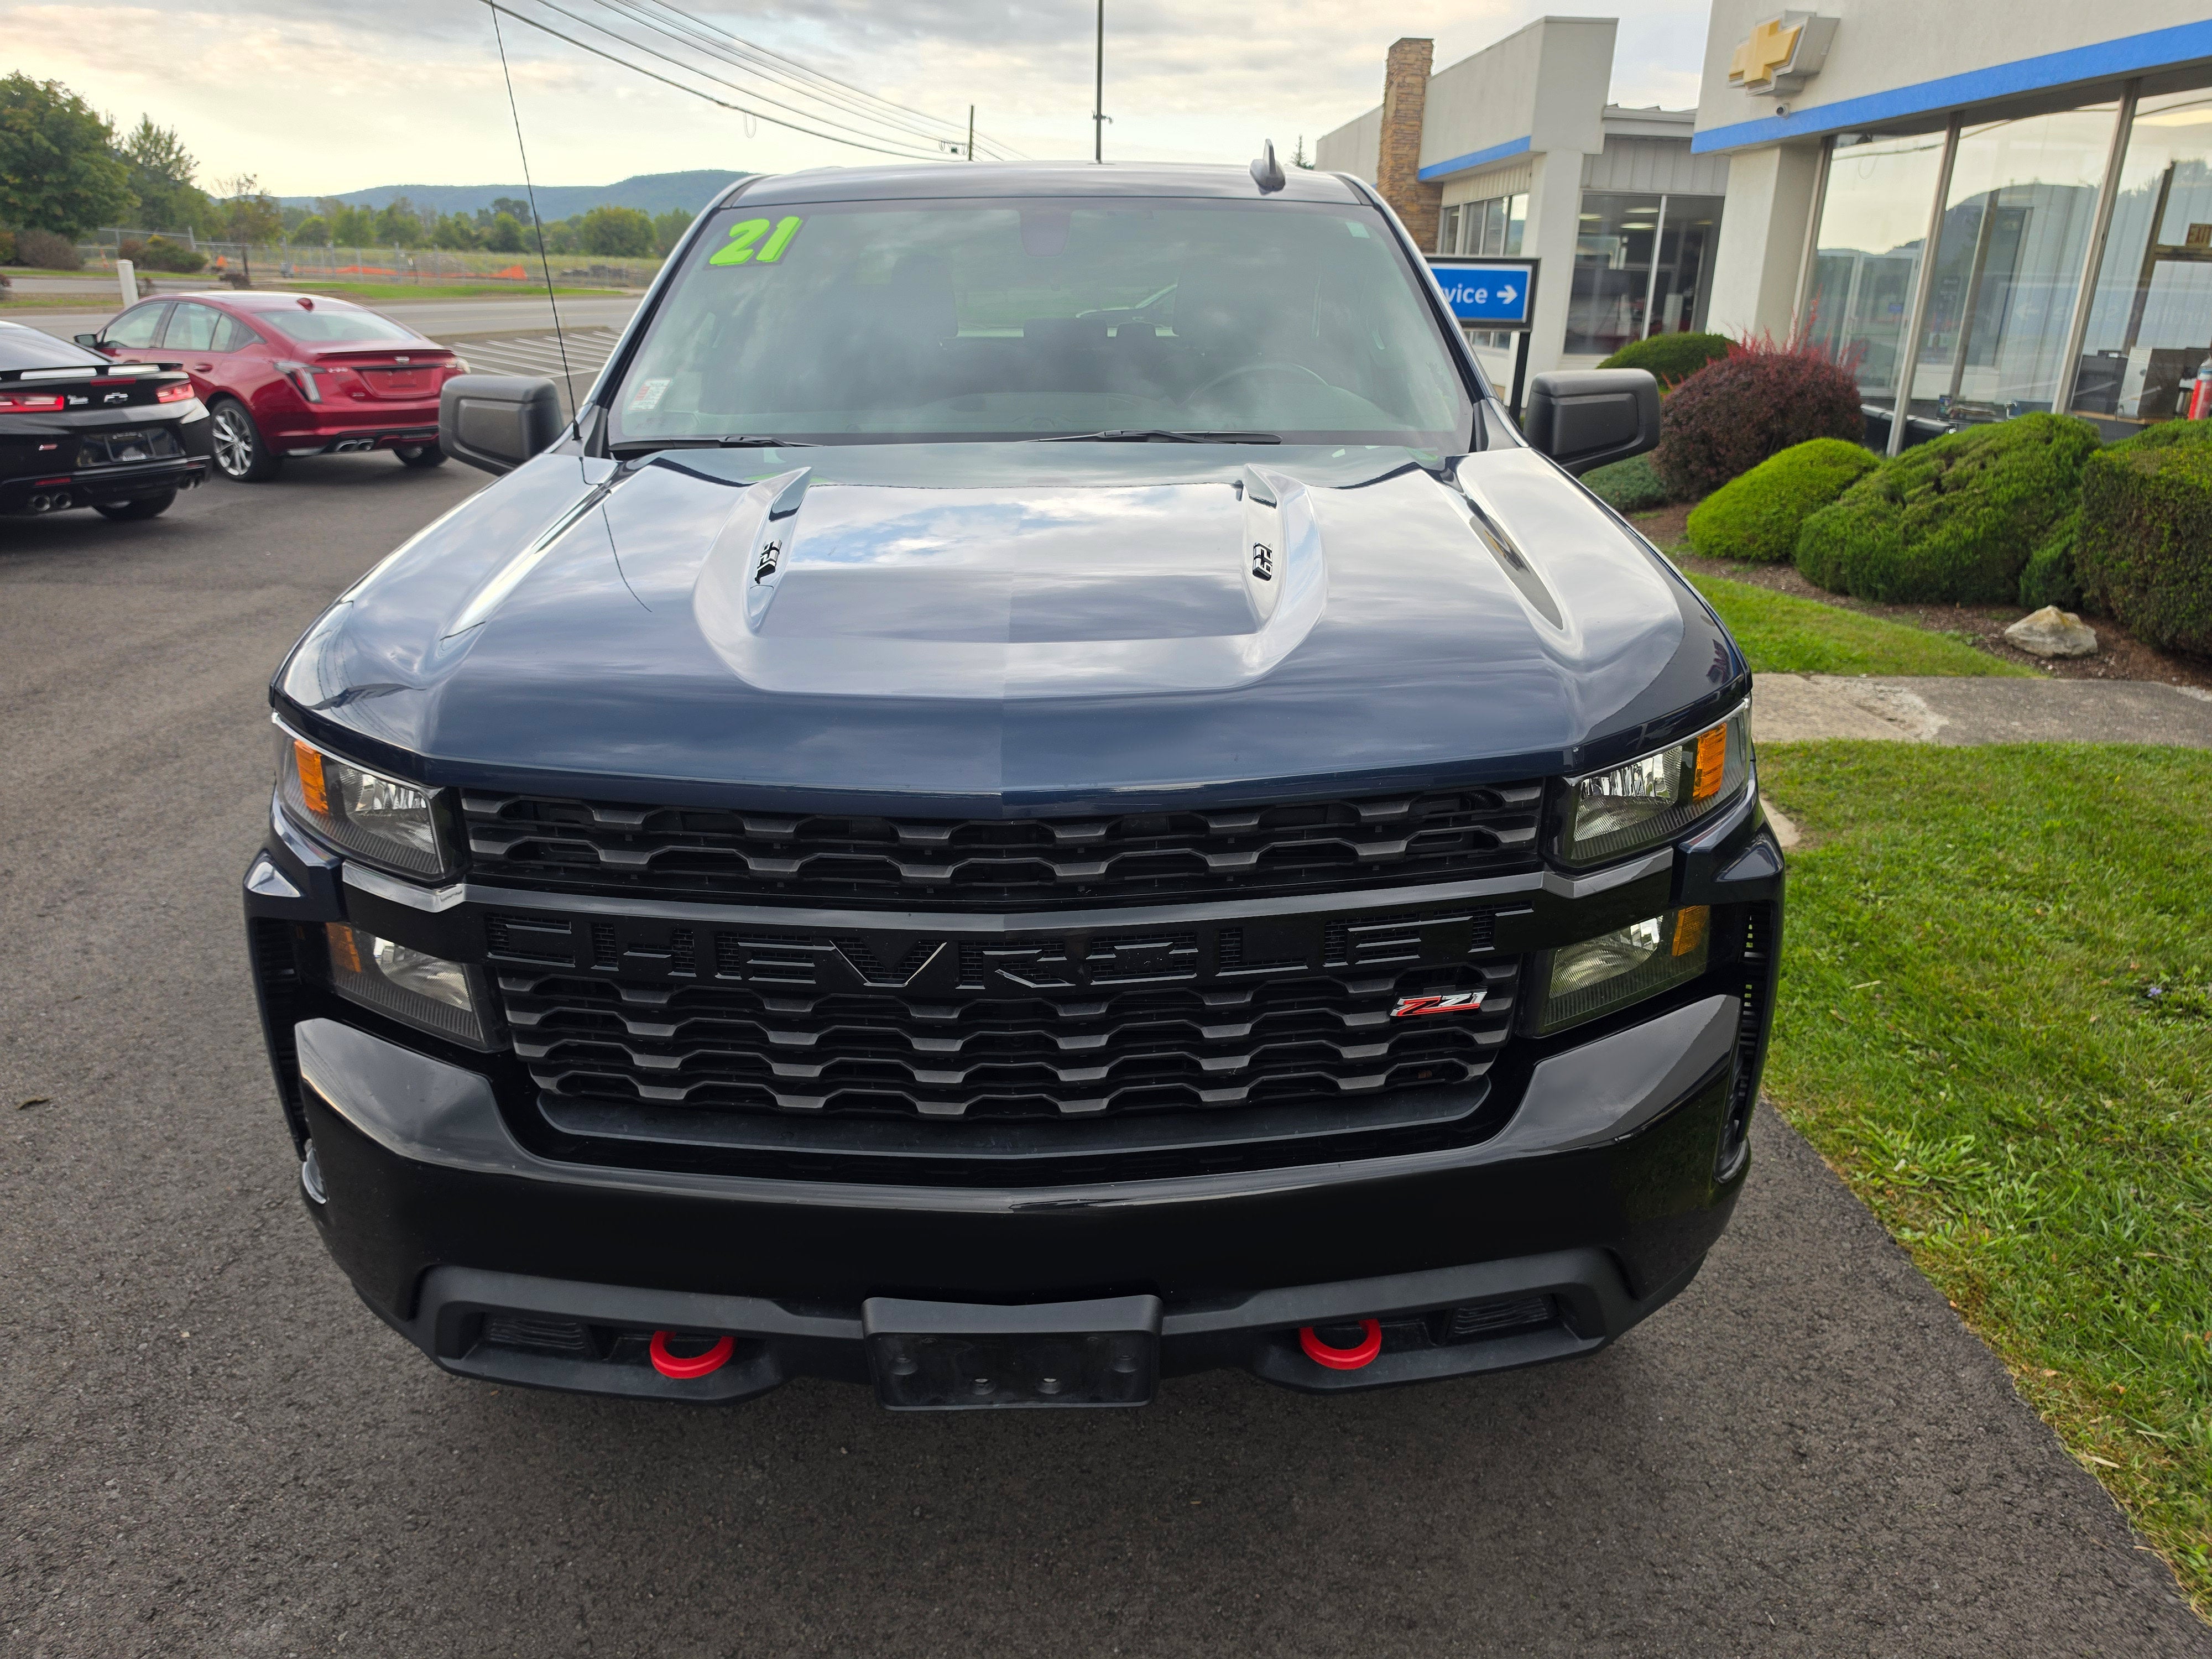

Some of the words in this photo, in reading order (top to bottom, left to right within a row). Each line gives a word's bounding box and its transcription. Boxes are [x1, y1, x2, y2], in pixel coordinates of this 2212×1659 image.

[709, 216, 803, 266] 21
[1441, 283, 1488, 304] vice
[486, 900, 1535, 988] CHEVROLET
[1390, 992, 1488, 1017] Z71
